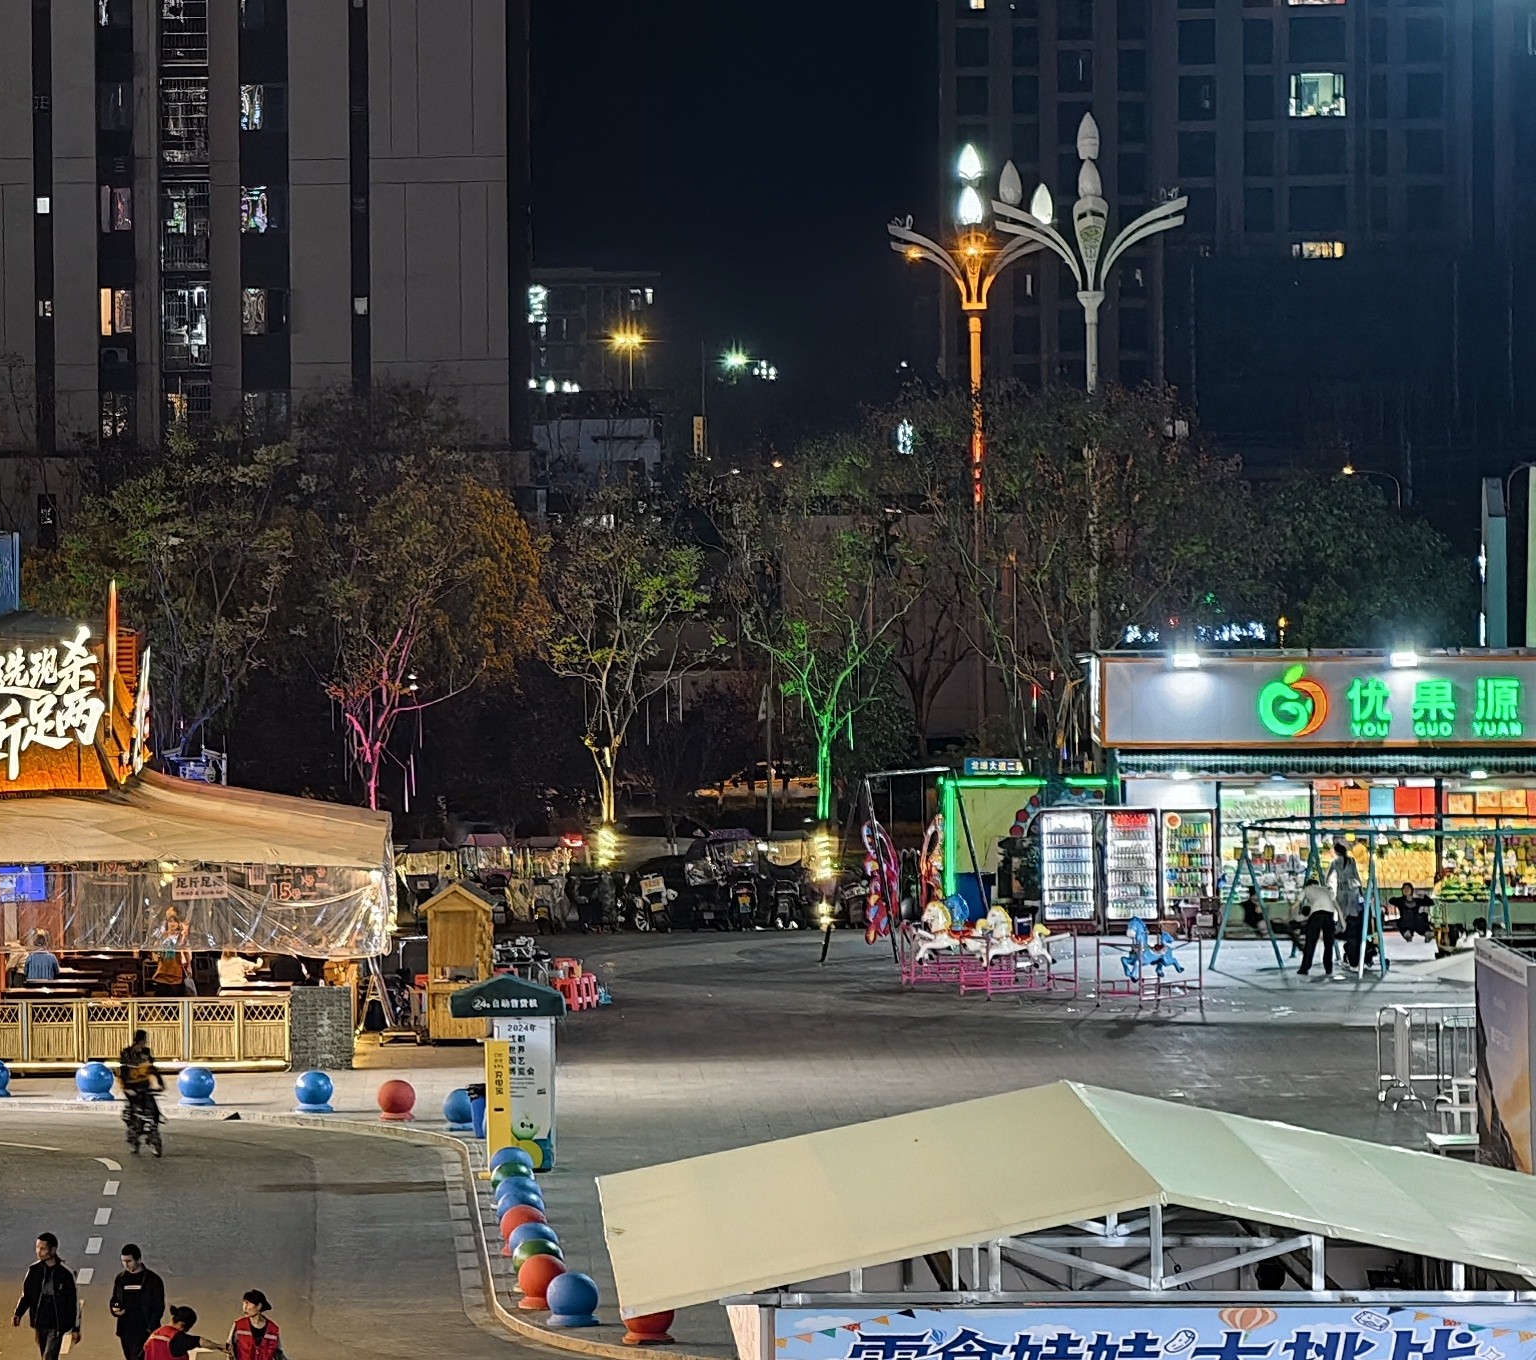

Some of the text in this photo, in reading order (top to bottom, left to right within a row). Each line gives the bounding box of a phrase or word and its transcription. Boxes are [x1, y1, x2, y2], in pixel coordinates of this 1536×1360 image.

[1346, 677, 1523, 722] 优果源
[1351, 723, 1523, 738] YOU GUO YUAN
[507, 1024, 537, 1032] 2024年
